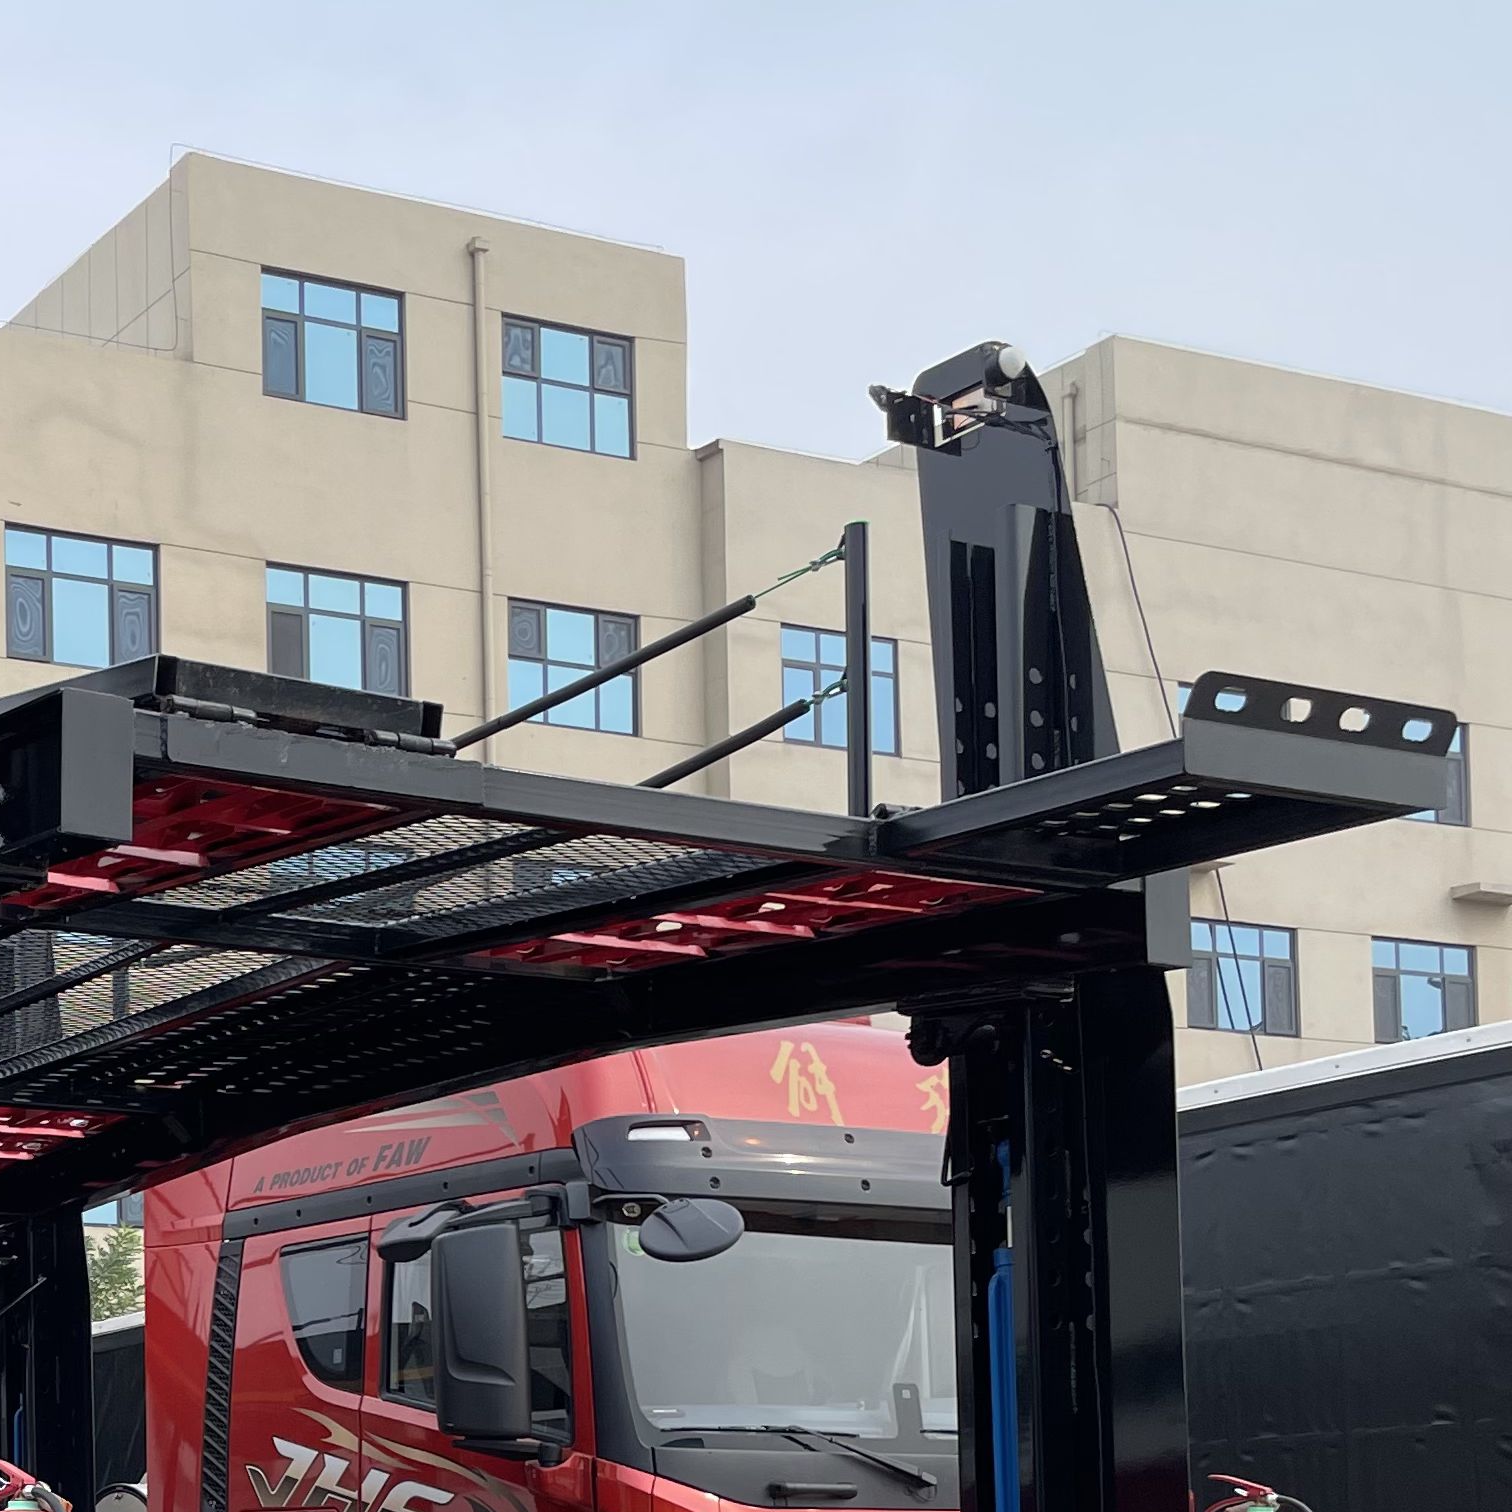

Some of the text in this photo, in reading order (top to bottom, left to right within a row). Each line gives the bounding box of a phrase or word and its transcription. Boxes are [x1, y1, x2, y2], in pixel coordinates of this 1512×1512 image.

[252, 1136, 433, 1194] A PRODUCT OF FAW
